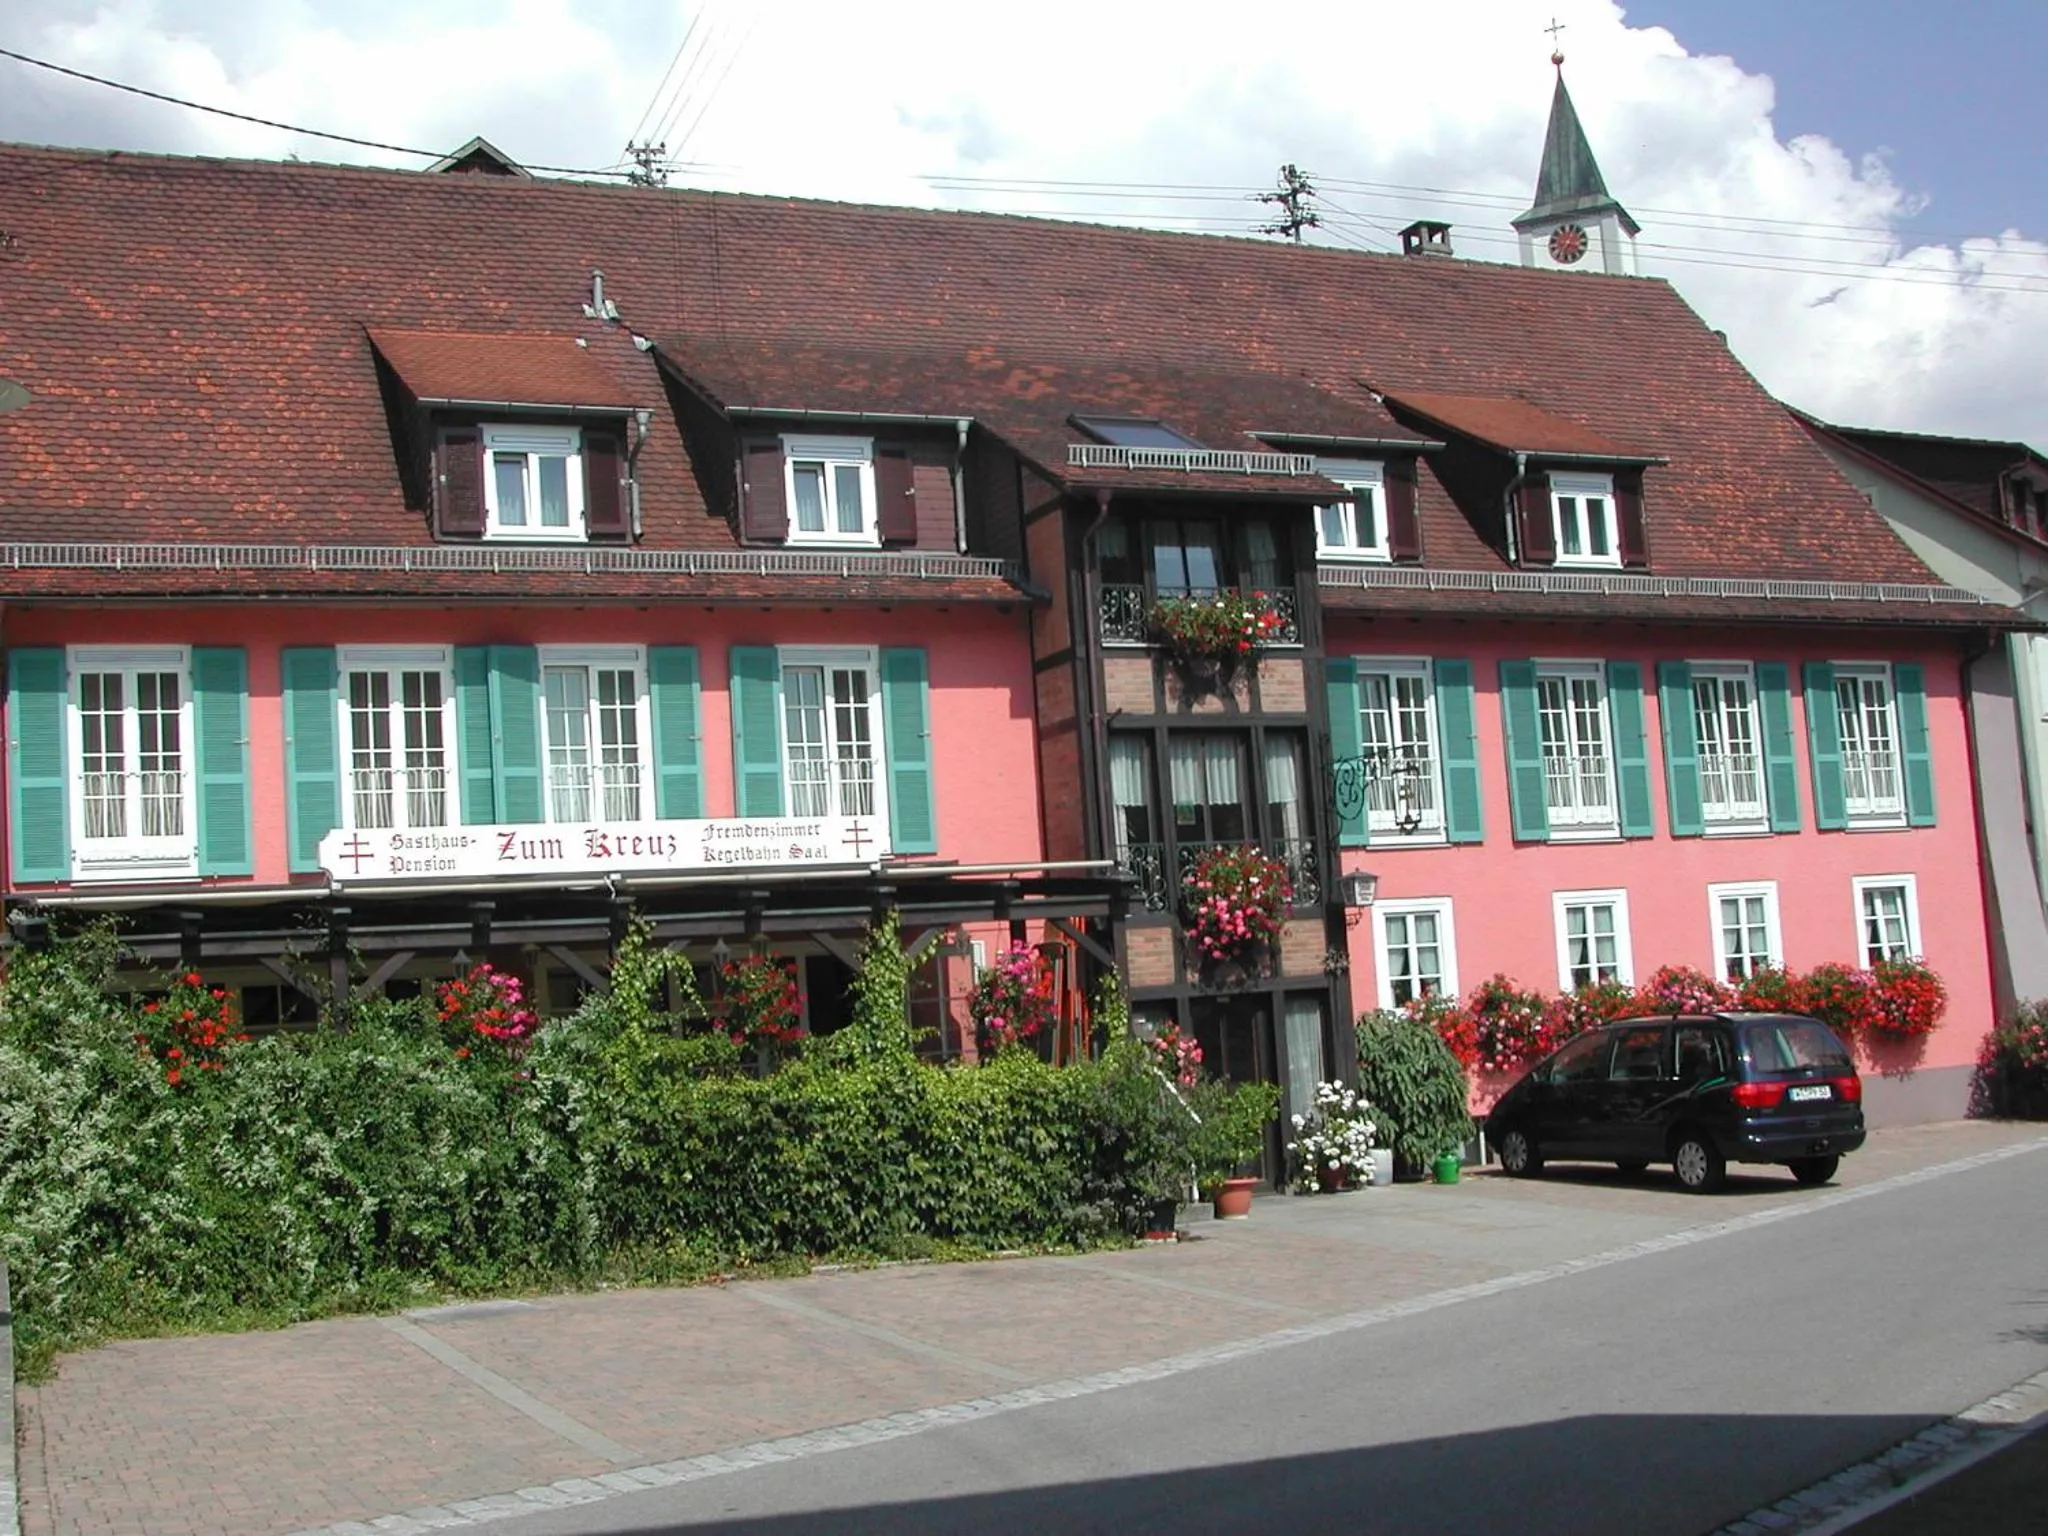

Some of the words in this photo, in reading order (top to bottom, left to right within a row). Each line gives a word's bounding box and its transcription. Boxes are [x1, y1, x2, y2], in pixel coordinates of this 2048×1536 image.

[389, 833, 477, 851] Gasthaus-
[701, 823, 821, 842] Fremdenzimmer
[497, 831, 564, 861] Zum
[584, 828, 677, 862] Kreuz
[703, 845, 781, 864] Kegelbahn
[788, 843, 828, 860] Saal
[389, 855, 456, 873] Pension
